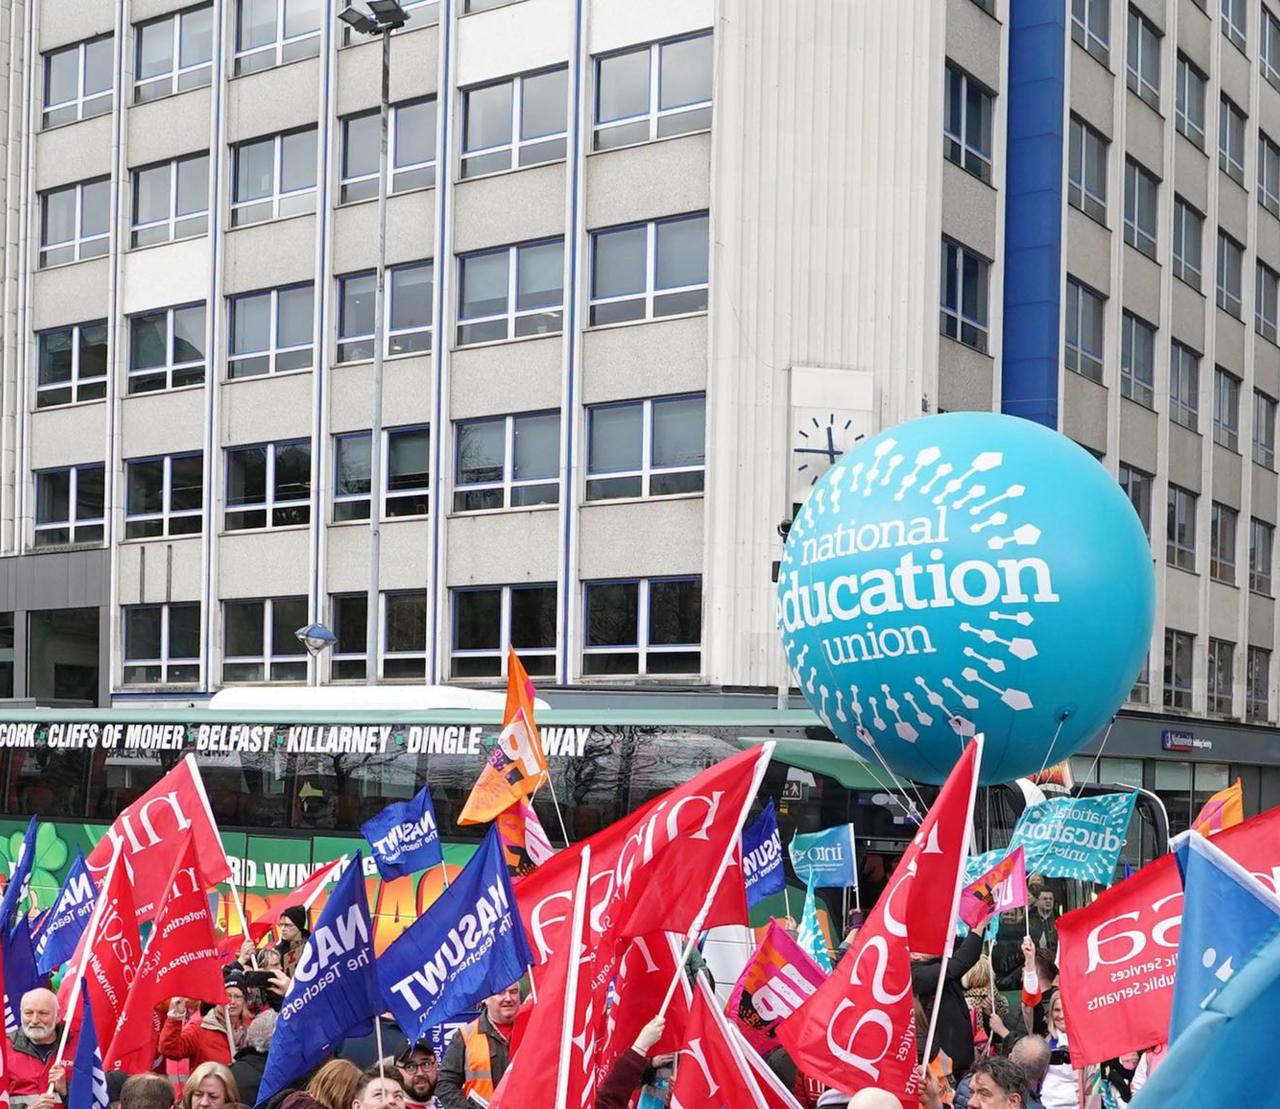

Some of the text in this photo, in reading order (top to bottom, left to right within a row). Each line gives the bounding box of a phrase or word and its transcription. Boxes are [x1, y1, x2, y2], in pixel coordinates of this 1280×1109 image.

[801, 505, 950, 567] national
[822, 621, 937, 666] union
[47, 724, 99, 750] CLIFFS
[101, 725, 124, 750] OF
[125, 725, 185, 751] MOHER
[196, 725, 276, 753] BELFAST
[286, 726, 393, 754] KILLARNEY
[407, 727, 483, 755] DINGLE
[541, 727, 591, 758] WAY
